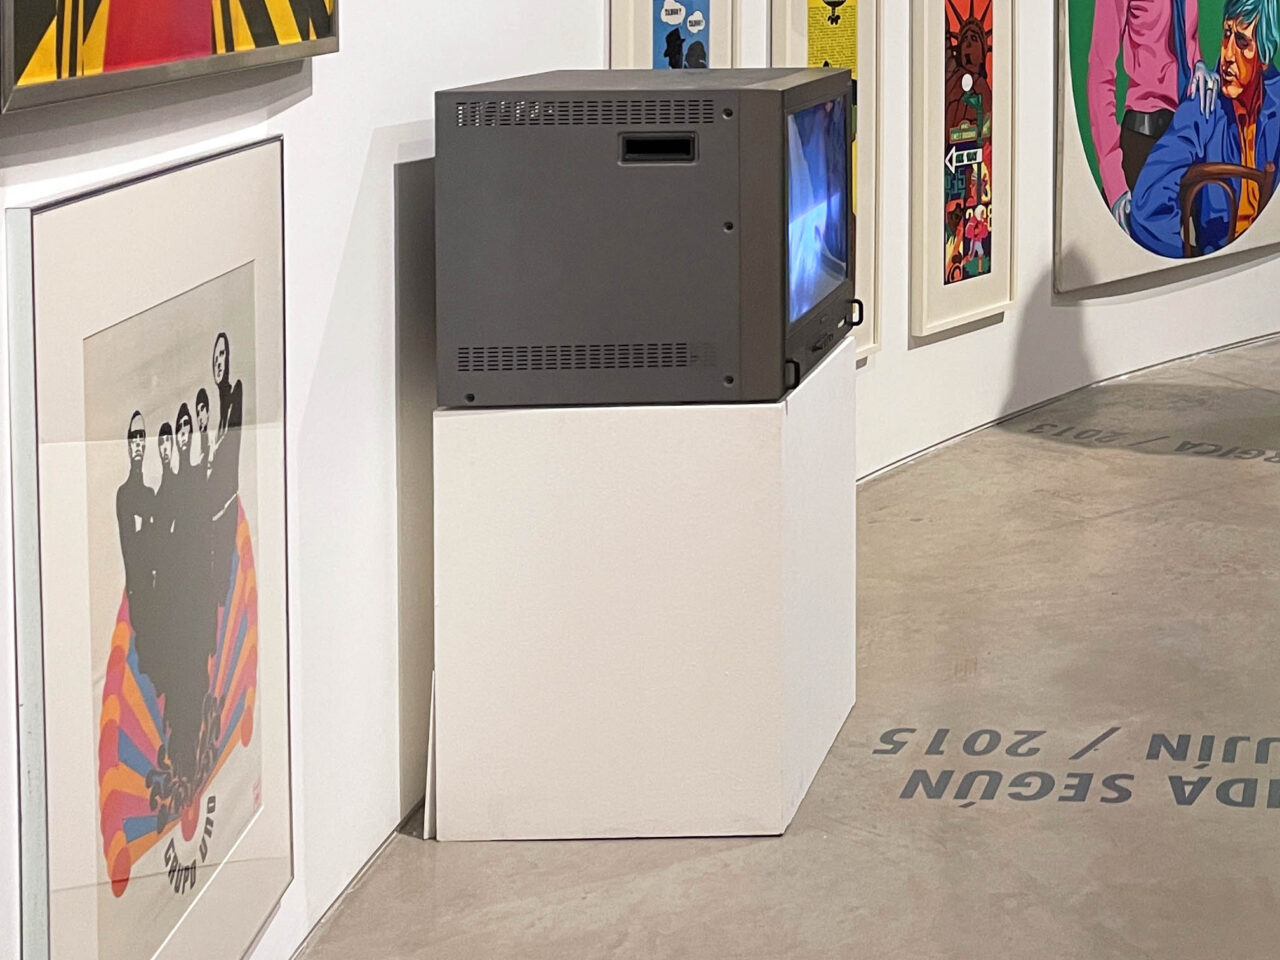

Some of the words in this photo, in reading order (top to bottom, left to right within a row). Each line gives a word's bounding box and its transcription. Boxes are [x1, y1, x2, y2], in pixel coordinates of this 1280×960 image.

[1026, 424, 1128, 444] 2013
[872, 728, 1047, 758] 2015
[900, 769, 1135, 809] SEGÚN
[164, 837, 196, 895] GRUPO
